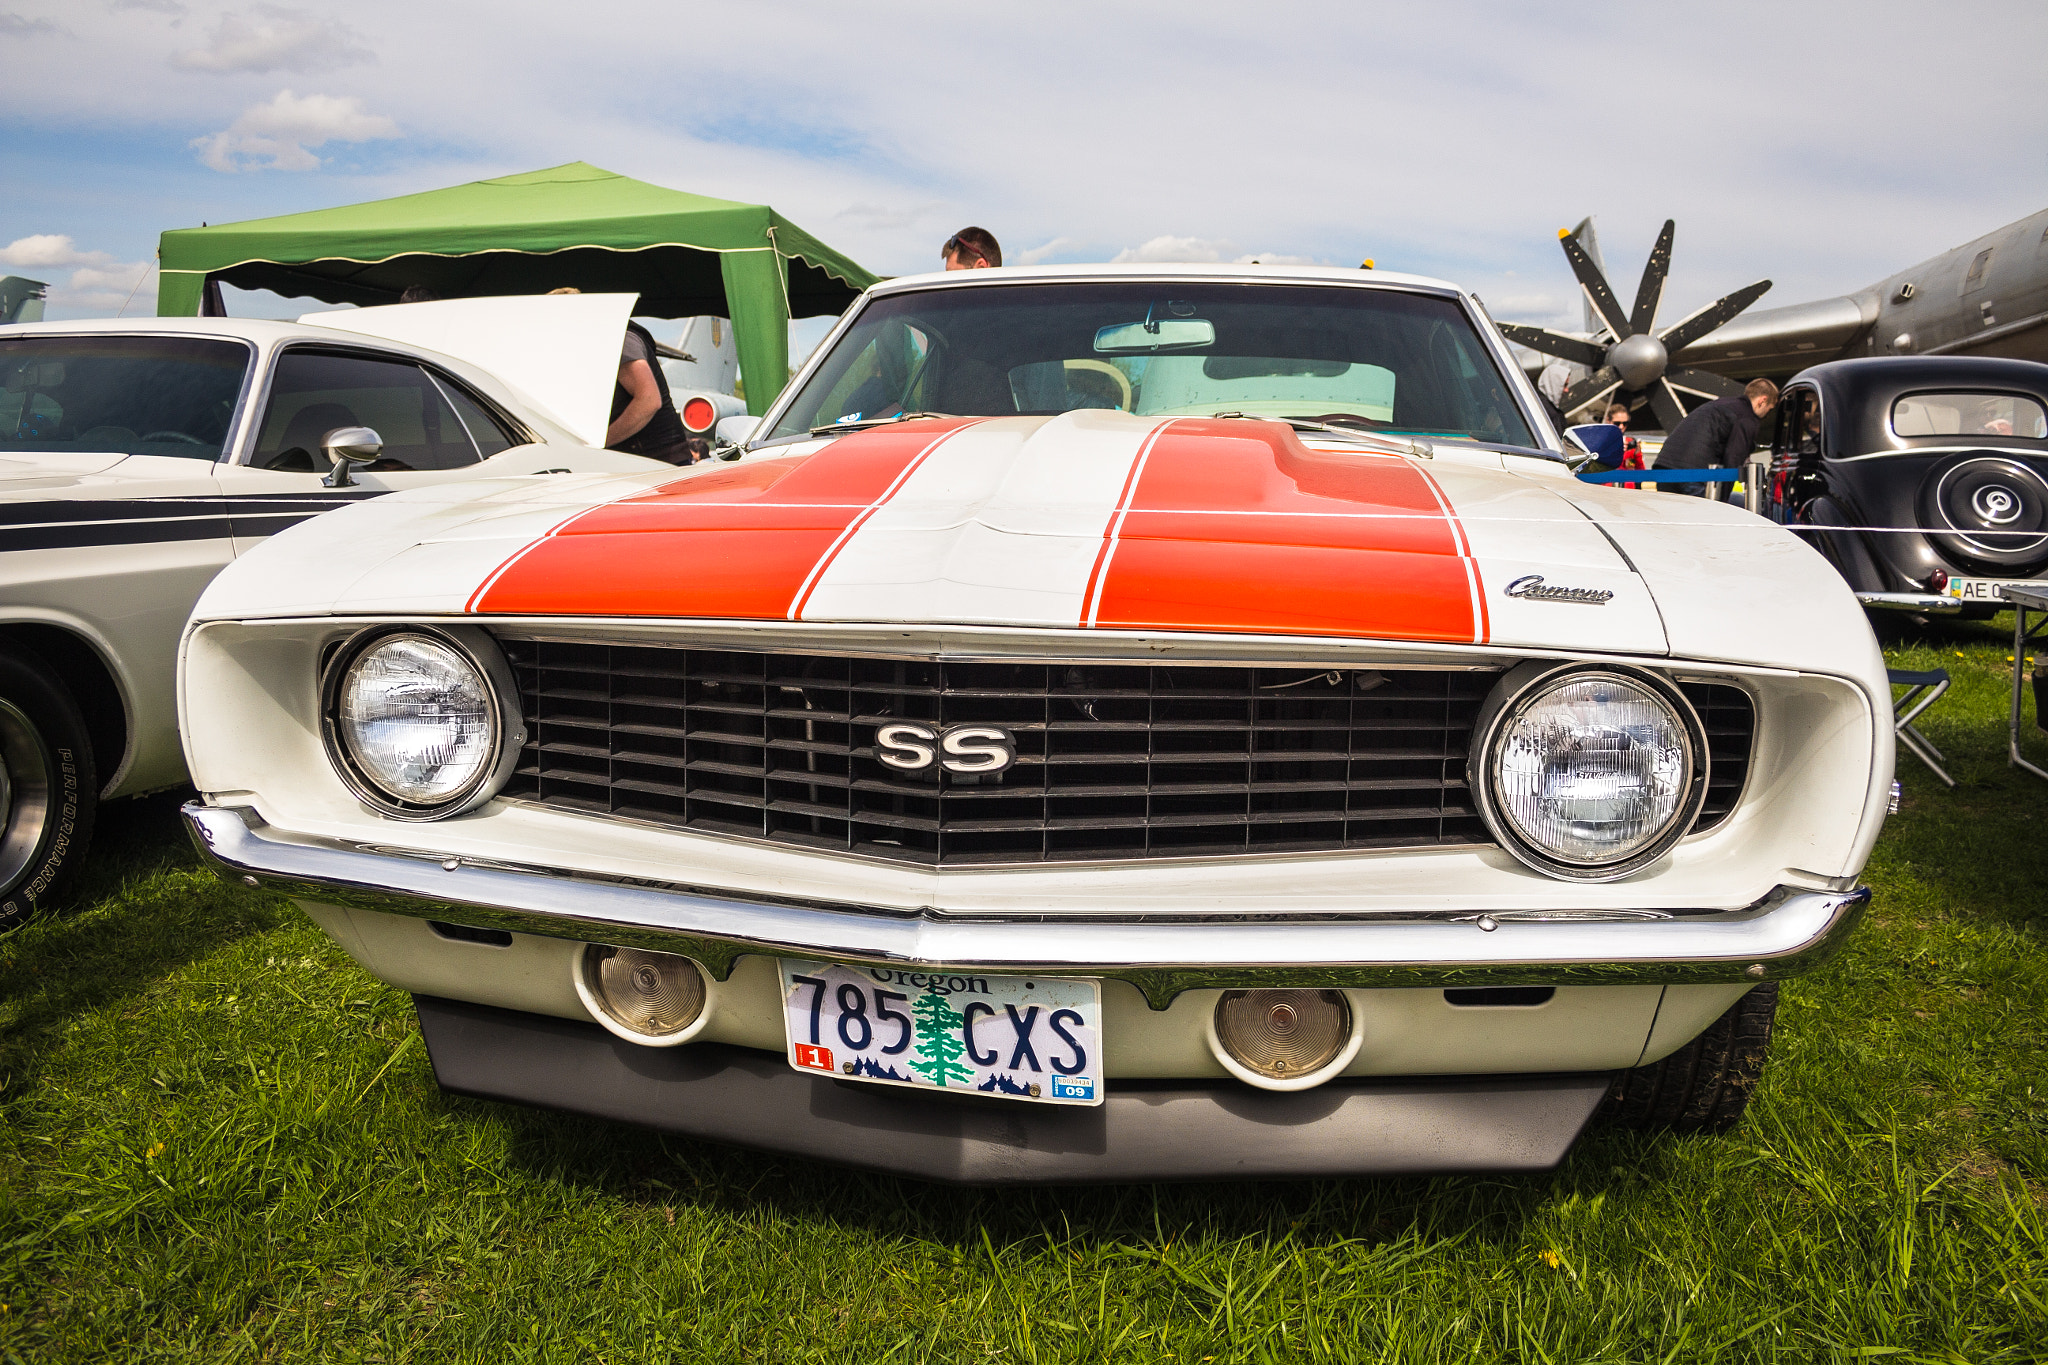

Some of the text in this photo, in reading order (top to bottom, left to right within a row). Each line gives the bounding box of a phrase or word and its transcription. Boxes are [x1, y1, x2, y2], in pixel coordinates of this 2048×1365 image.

[1504, 575, 1614, 604] Camaro
[1963, 583, 1988, 598] AE
[877, 723, 1010, 772] SS
[24, 748, 77, 902] PERFORMANCE
[870, 969, 993, 996] Oregon
[792, 975, 1087, 1075] 785 CXS
[808, 1048, 824, 1067] 1
[1065, 1086, 1085, 1097] 09
